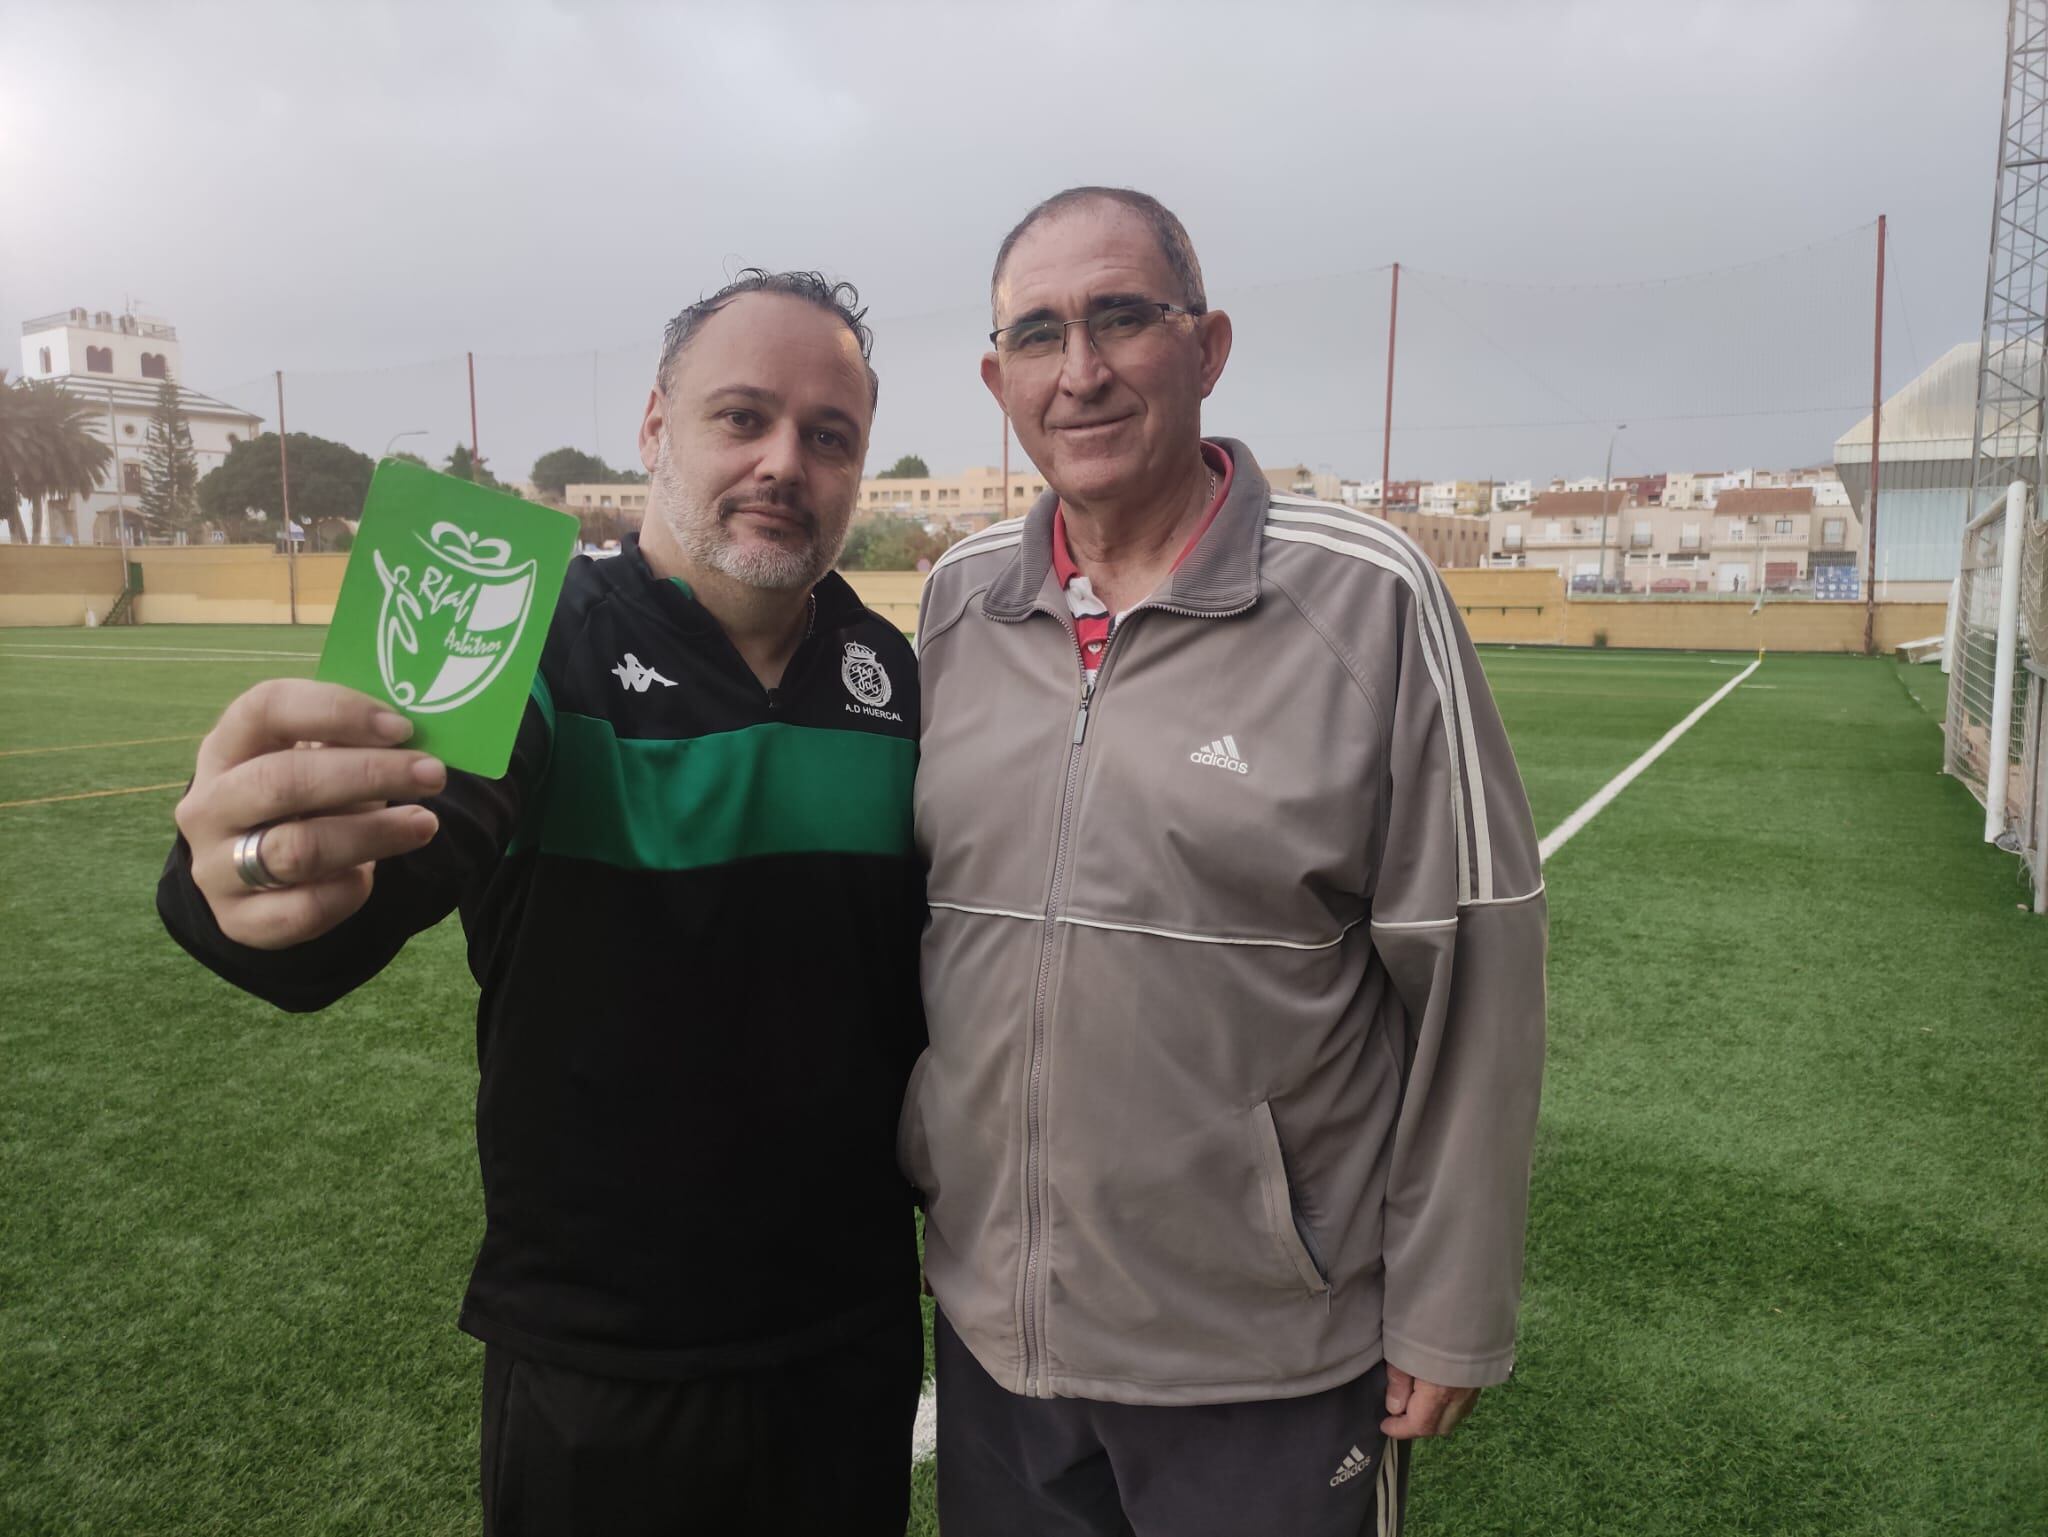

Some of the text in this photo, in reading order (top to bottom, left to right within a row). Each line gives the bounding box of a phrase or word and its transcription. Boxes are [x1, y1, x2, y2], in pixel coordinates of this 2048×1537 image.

[862, 706, 903, 722] HUERCAL
[1190, 752, 1248, 774] adidas
[1329, 1455, 1371, 1487] adidas
